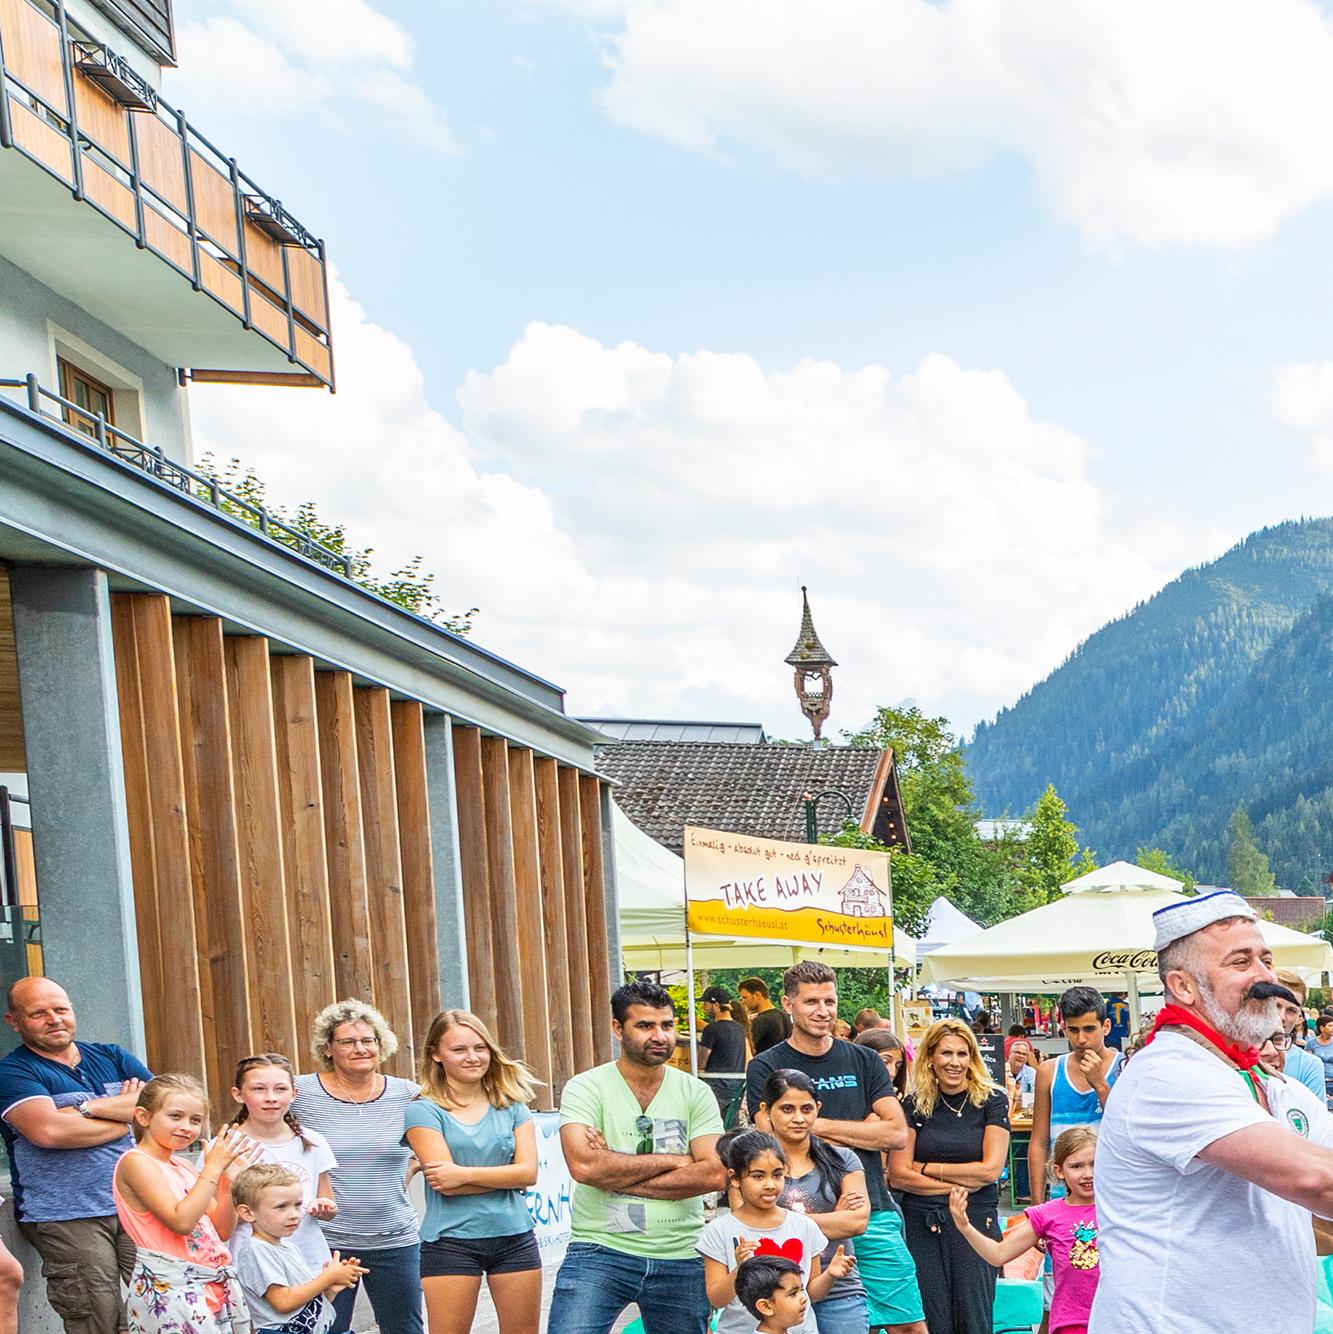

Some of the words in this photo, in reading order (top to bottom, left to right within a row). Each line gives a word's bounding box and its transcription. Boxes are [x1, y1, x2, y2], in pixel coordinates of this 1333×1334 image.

[764, 849, 777, 861] gut
[719, 877, 767, 907] TAKE
[776, 872, 823, 899] AWAY
[697, 913, 789, 931] www.schusterhaeusl.at
[816, 918, 888, 939] Schusterhäusl
